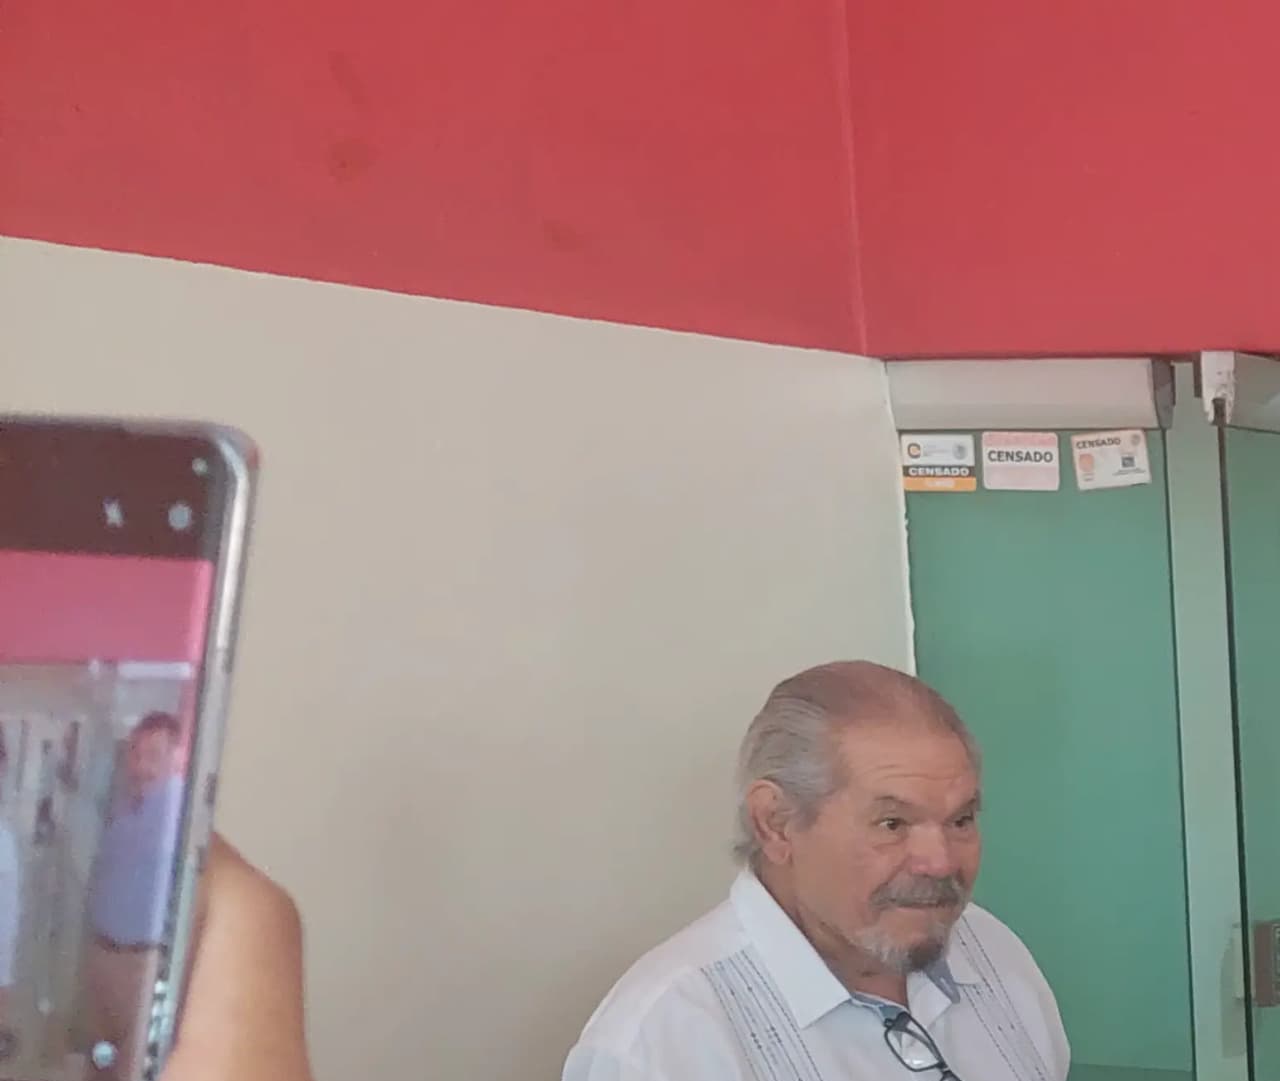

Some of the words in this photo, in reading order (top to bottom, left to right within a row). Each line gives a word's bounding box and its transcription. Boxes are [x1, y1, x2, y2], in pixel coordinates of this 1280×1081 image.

[1076, 437, 1122, 450] CENSADO
[987, 449, 1054, 464] CENSADO
[908, 466, 970, 477] CENSADO
